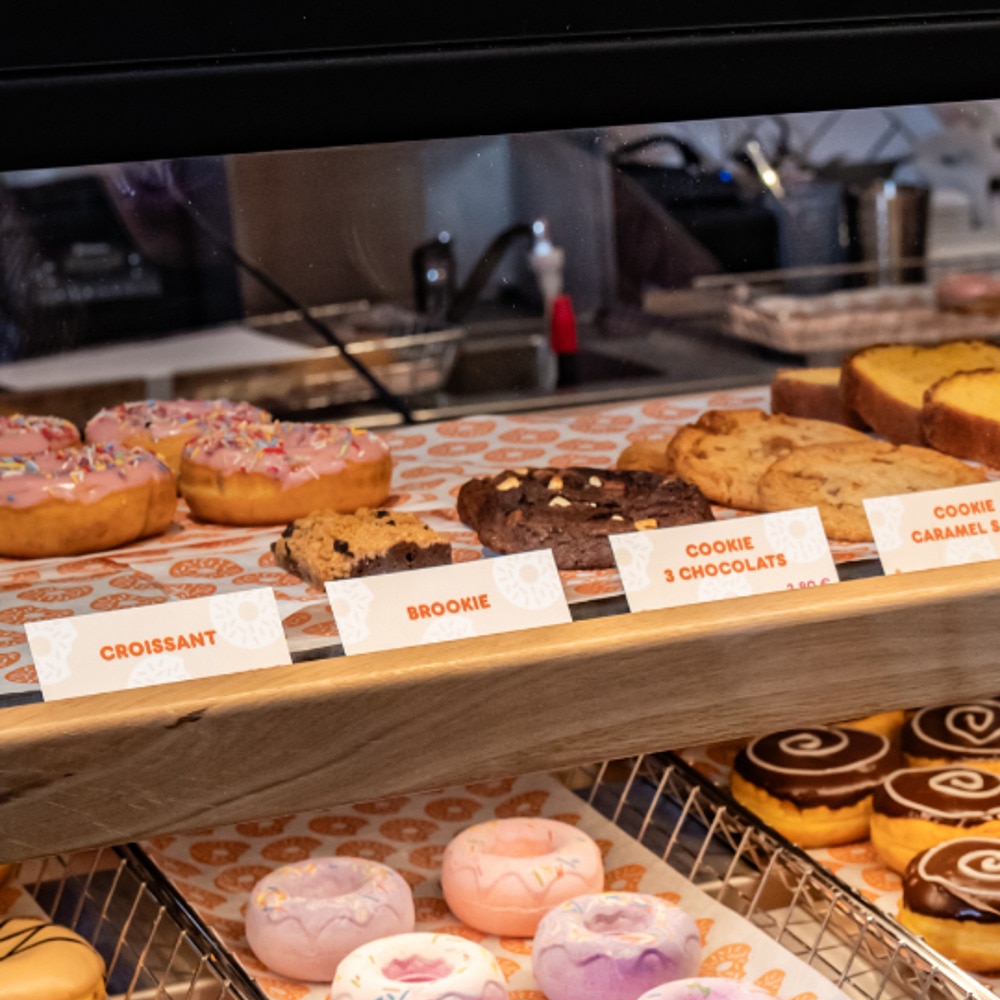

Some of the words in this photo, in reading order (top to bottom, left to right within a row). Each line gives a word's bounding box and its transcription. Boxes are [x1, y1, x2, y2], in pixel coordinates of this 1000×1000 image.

[933, 499, 996, 519] COOKIE
[911, 522, 987, 544] CARAMEL
[685, 536, 755, 558] COOKIE
[664, 568, 675, 583] 3
[679, 554, 788, 581] CHOCOLATS
[406, 594, 491, 621] BROOKIE
[100, 630, 217, 662] CROISSANT
